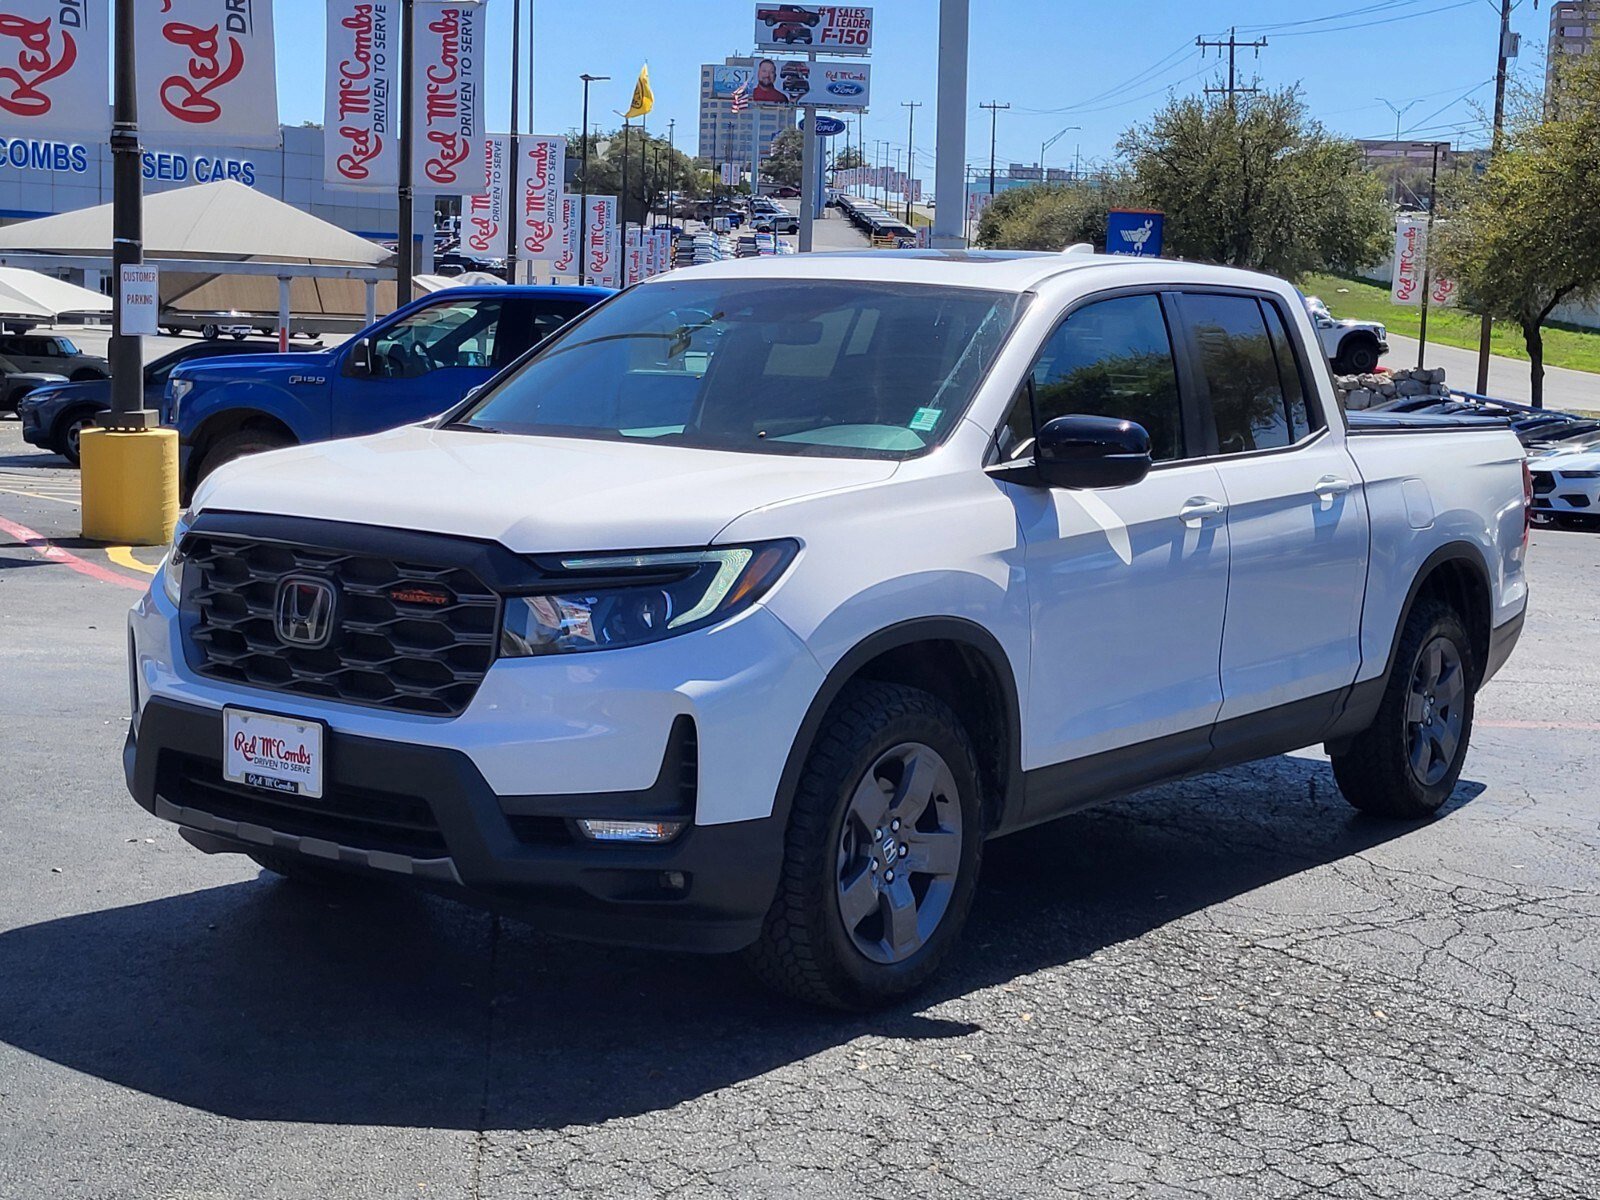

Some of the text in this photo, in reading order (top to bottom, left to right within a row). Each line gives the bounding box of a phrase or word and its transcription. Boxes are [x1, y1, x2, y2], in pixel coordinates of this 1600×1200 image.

[818, 7, 865, 27] #1 SALES
[836, 18, 870, 28] LEADER
[821, 28, 868, 45] F-150
[0, 14, 77, 116] Red
[160, 22, 244, 124] Red
[374, 4, 386, 133] DRIVEN TO SERVE
[460, 10, 473, 136] DRIVEN TO SERVE
[826, 71, 838, 82] Red
[337, 4, 382, 179] Red McCombs
[425, 9, 470, 184] Red McCombs
[833, 83, 857, 94] Ford
[548, 142, 557, 168] SERVE
[195, 157, 255, 187] CARS
[492, 140, 502, 222] DRIVEN TO SERVE
[548, 172, 556, 186] TO
[525, 142, 553, 252] Red McCombs
[469, 218, 498, 251] Red
[590, 200, 606, 248] McCombs
[606, 220, 610, 228] TO
[590, 250, 608, 272] Red
[1396, 227, 1416, 300] Red McCombs
[124, 272, 156, 282] CUSTOMER
[126, 294, 152, 304] PARKING
[234, 732, 311, 765] Red McCombs
[254, 756, 311, 774] DRIVEN TO SERVE
[249, 774, 262, 786] Red
